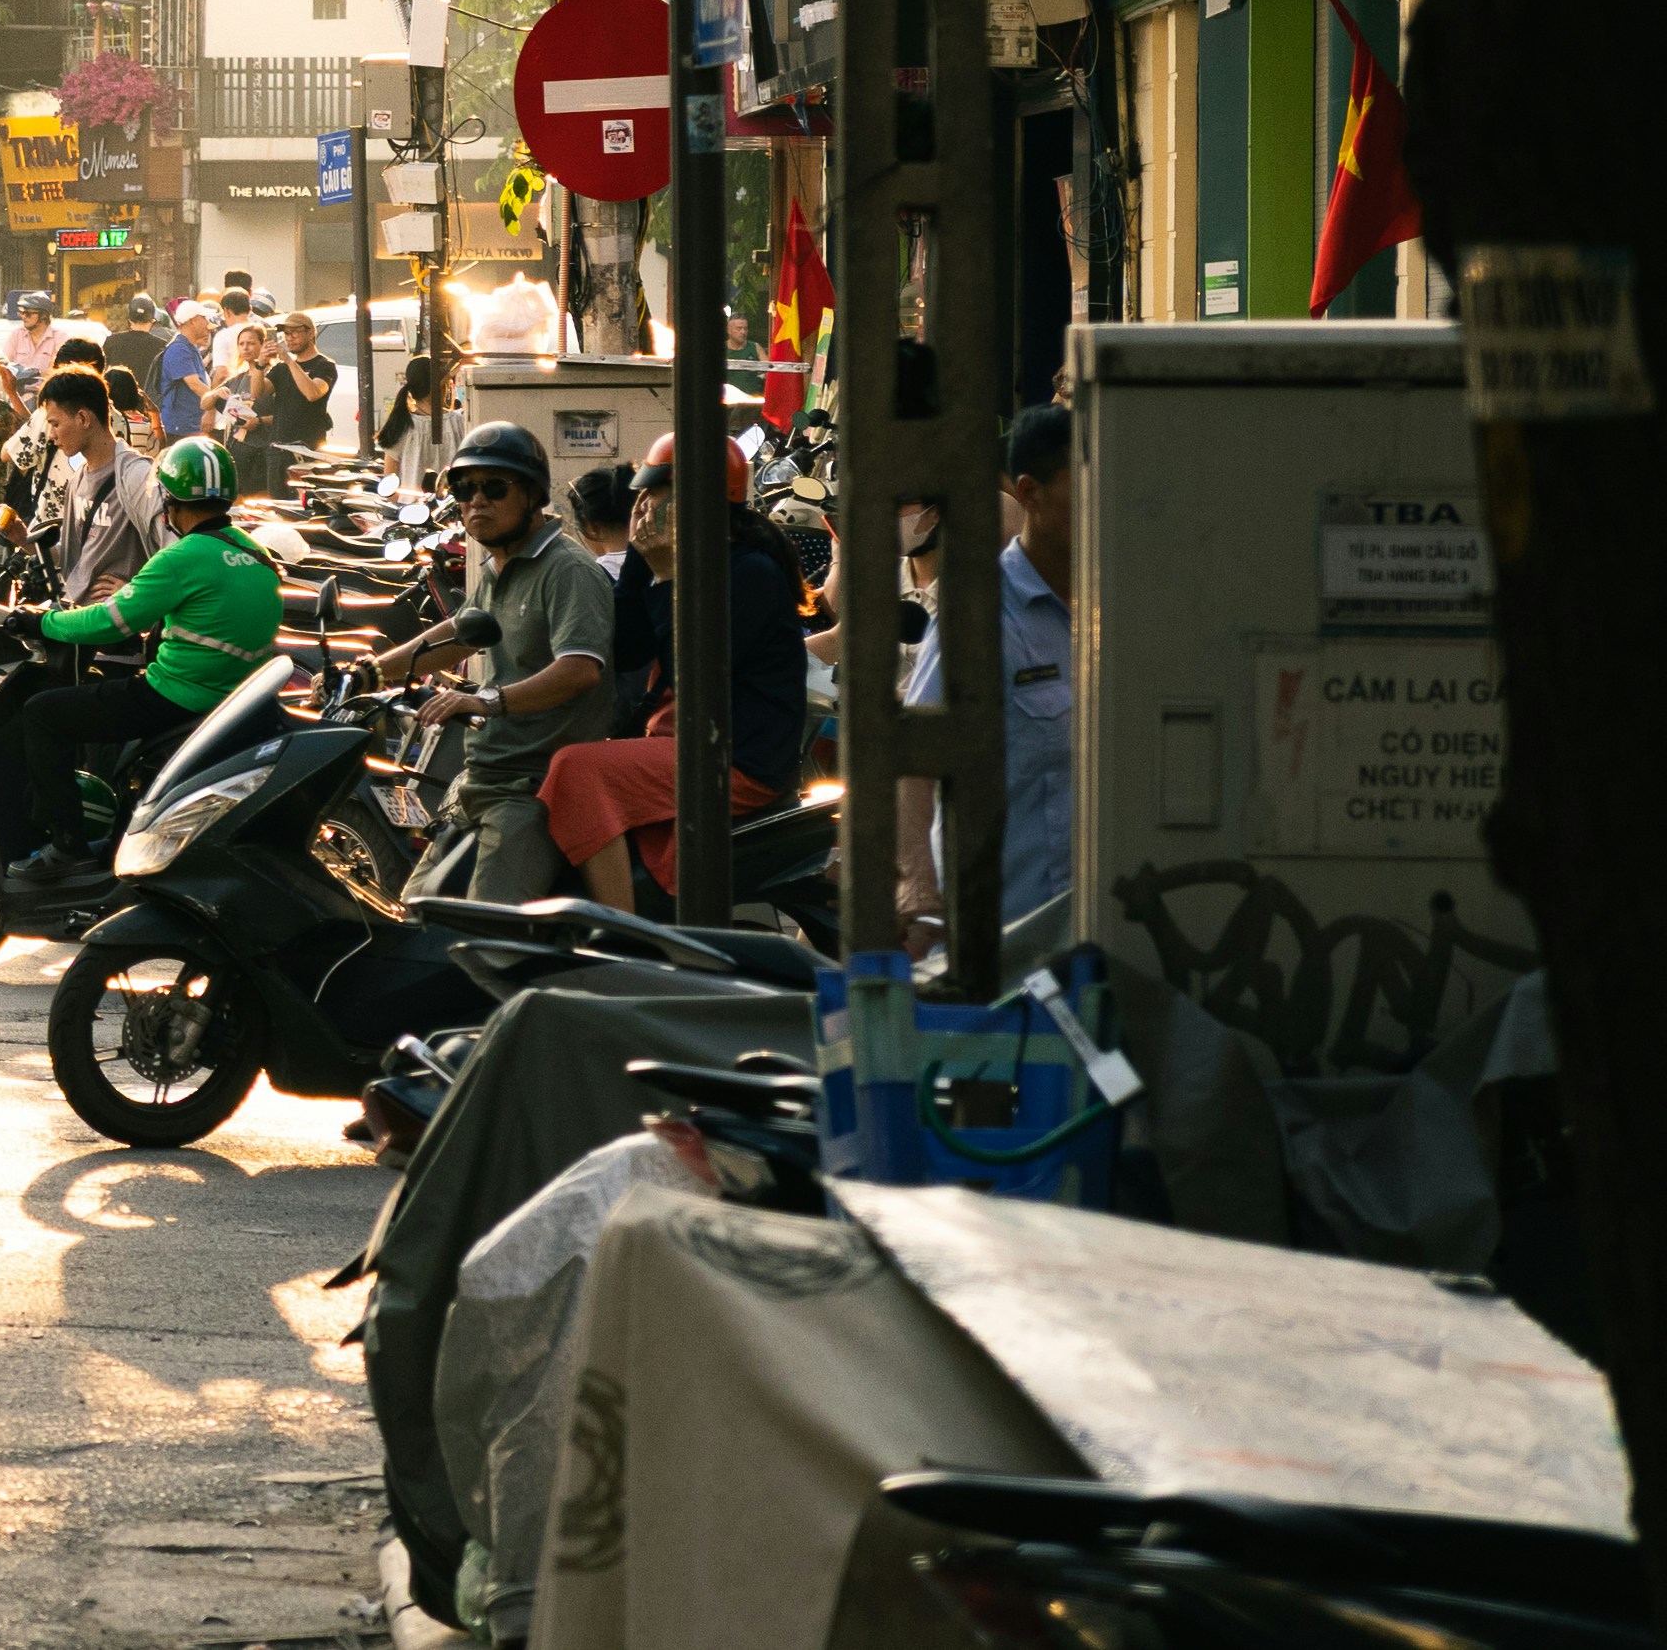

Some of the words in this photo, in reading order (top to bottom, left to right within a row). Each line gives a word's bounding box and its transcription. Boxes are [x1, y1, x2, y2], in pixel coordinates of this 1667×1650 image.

[80, 138, 138, 180] Mimosa
[256, 186, 312, 197] MATCHA
[60, 232, 98, 246] COFFEE
[564, 431, 598, 440] PILLAR
[1368, 502, 1462, 525] TBA
[1358, 766, 1439, 788] NGUY
